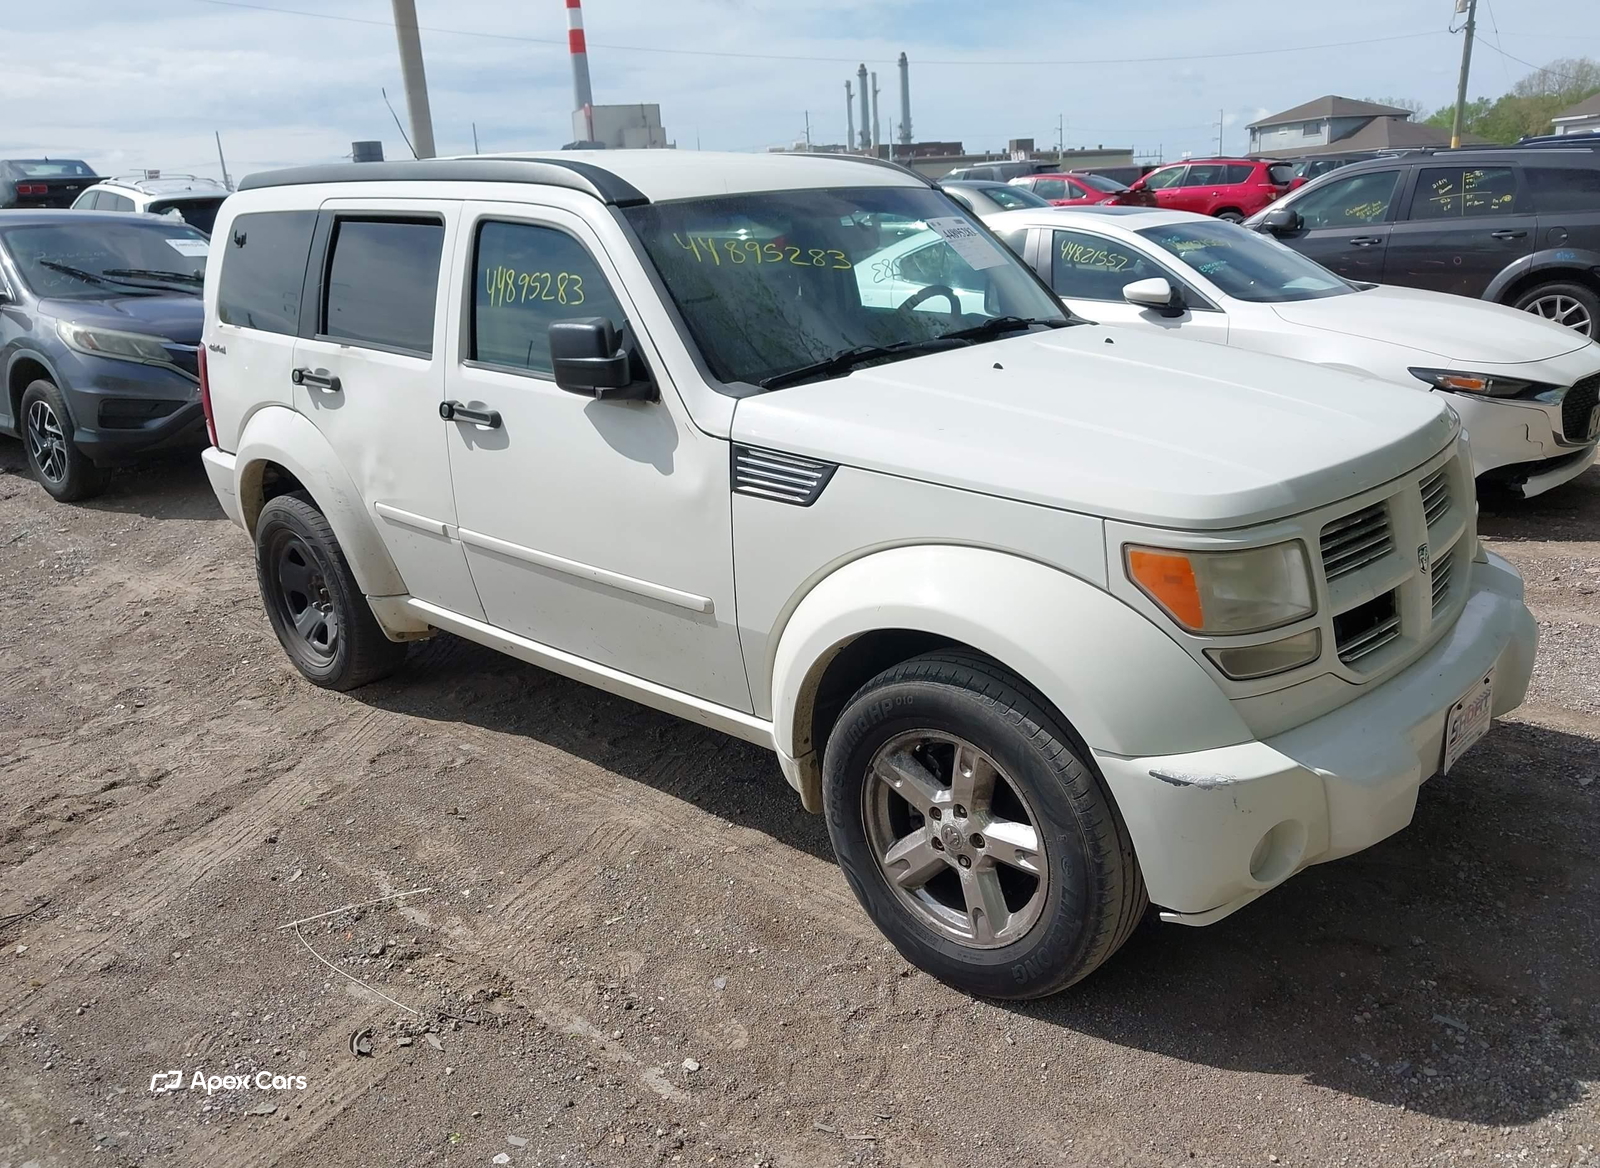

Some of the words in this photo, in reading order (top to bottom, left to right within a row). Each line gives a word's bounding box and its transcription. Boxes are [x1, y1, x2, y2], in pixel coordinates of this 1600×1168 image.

[673, 232, 852, 270] 44895283
[1060, 239, 1128, 271] 44821557
[486, 265, 585, 307] 44895283
[866, 698, 894, 725] HP
